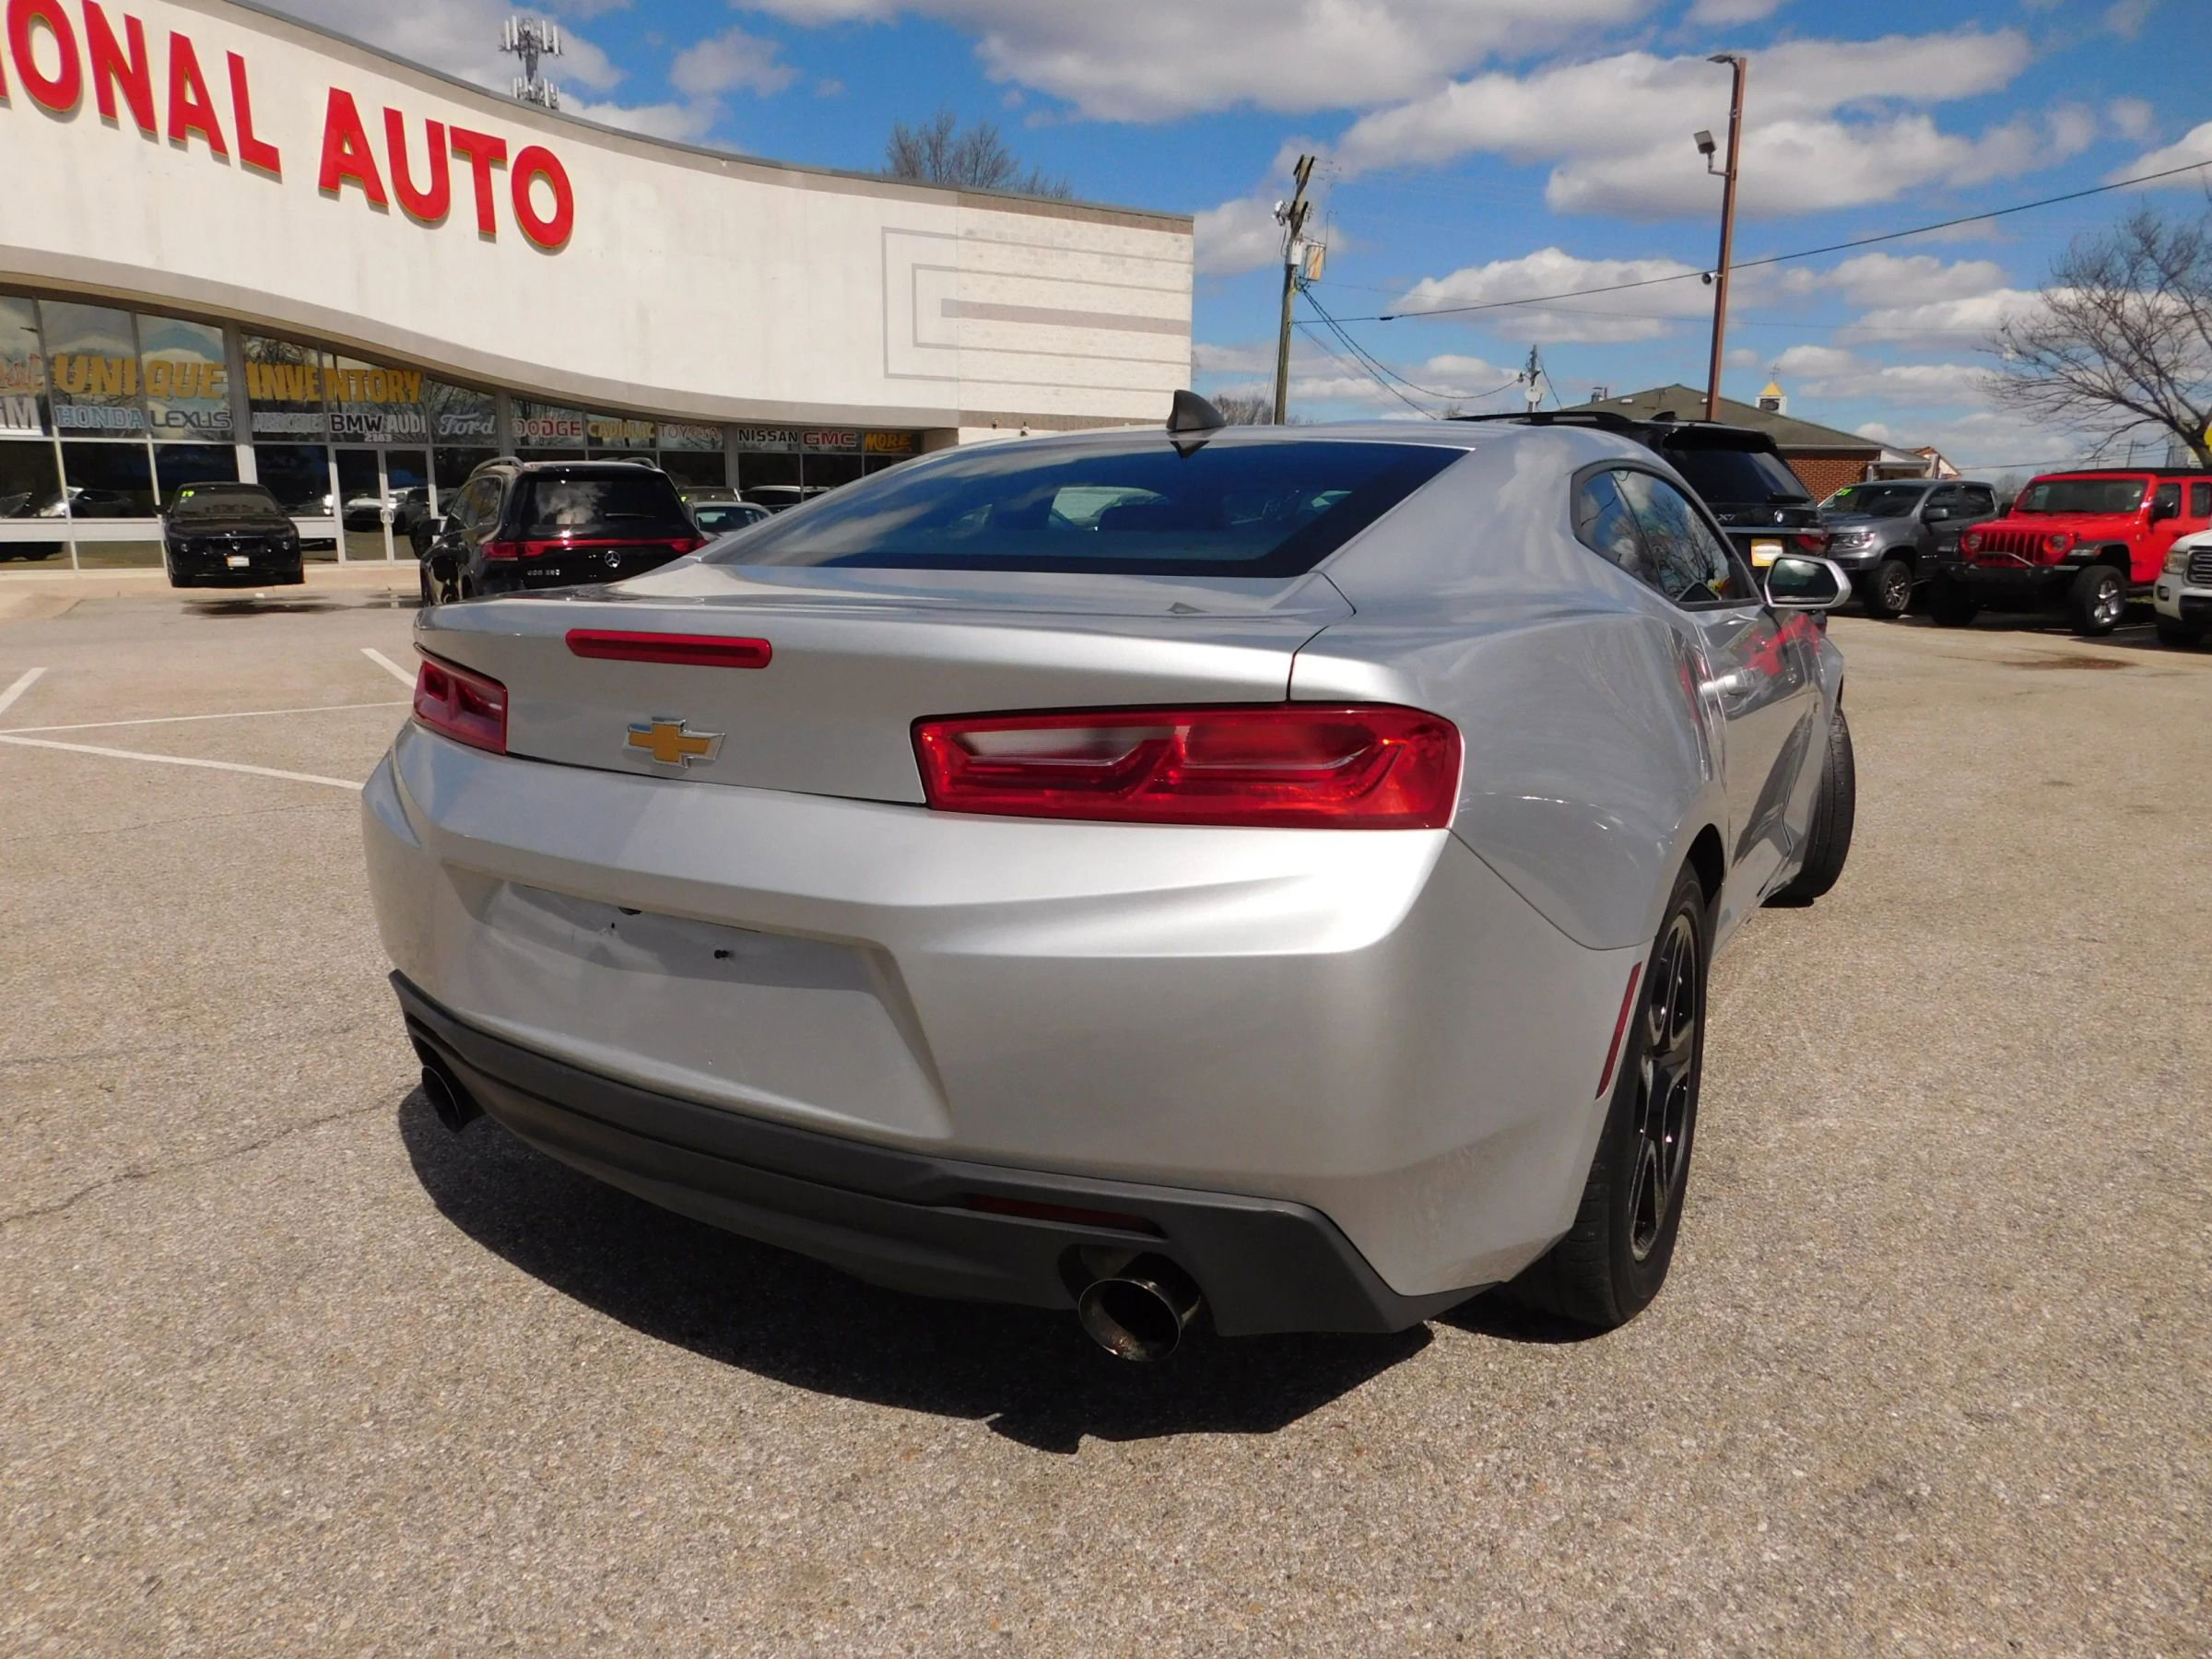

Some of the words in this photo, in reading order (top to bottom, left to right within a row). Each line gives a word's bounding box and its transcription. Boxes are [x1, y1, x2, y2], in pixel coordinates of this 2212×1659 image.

[0, 0, 281, 176] ONAL
[319, 87, 574, 249] AUTO
[53, 353, 228, 398] UNIQUE
[245, 361, 424, 404] INVENTORY
[55, 405, 146, 429] HONDA
[149, 409, 233, 429] LEXUS
[329, 413, 383, 434] BMW
[386, 413, 429, 434] AUDI
[439, 412, 496, 436] Ford
[513, 418, 582, 437] DODGE
[587, 419, 656, 440] CADILLAC
[659, 423, 723, 440] TOYOTA
[738, 429, 798, 443] NISSAN
[803, 430, 857, 447] GMC
[865, 433, 911, 452] MORE
